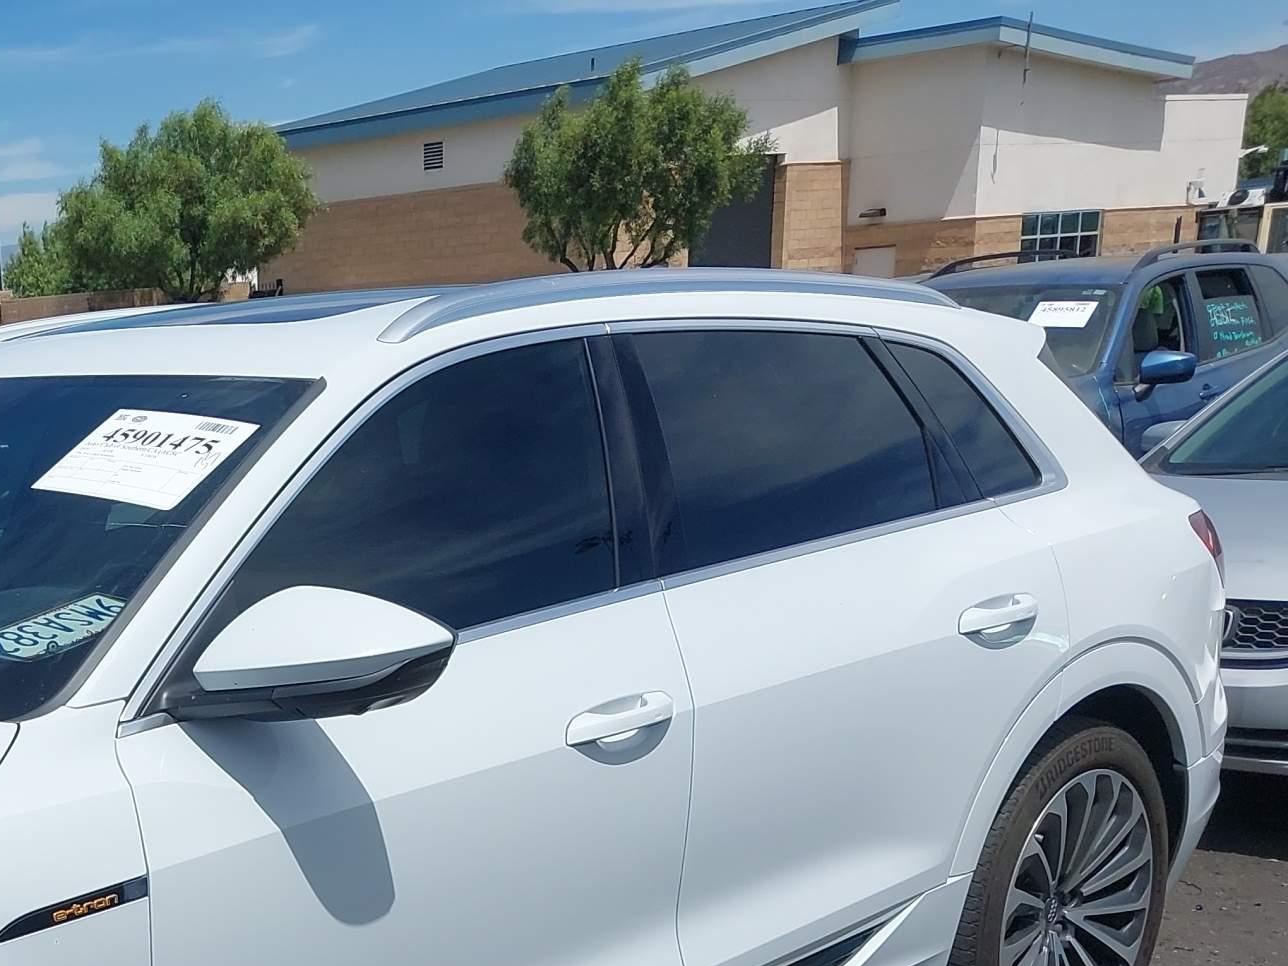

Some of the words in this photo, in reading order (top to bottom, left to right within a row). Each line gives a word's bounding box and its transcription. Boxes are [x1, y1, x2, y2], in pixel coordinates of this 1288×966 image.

[102, 427, 221, 455] 45901475
[1036, 736, 1114, 798] BRIDGESTONE
[53, 893, 119, 923] e-tron
